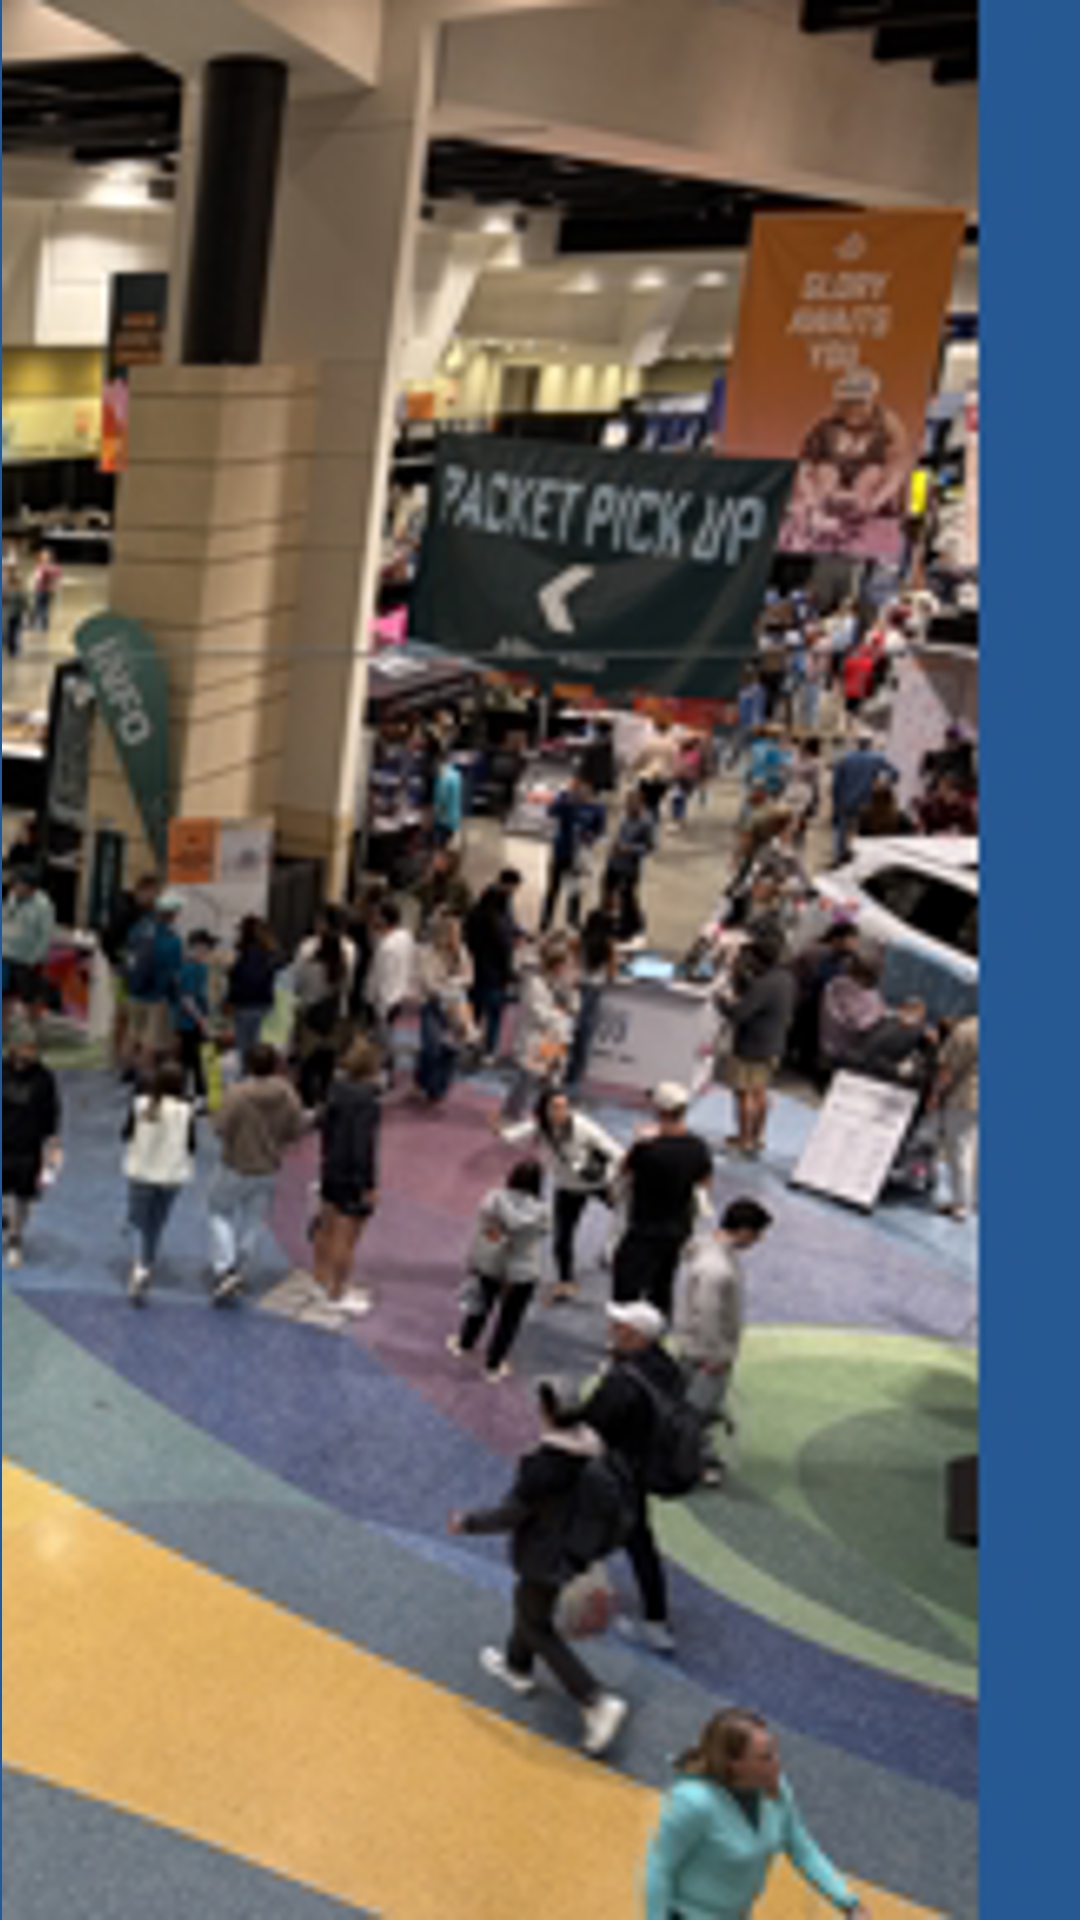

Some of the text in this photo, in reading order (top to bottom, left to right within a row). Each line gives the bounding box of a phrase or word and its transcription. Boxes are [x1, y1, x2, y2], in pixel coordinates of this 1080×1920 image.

[801, 271, 890, 301] GLORY
[786, 304, 892, 338] AWAITS
[806, 338, 861, 370] YOU
[440, 464, 766, 566] PACKET PICK UP
[88, 635, 152, 747] INFO
